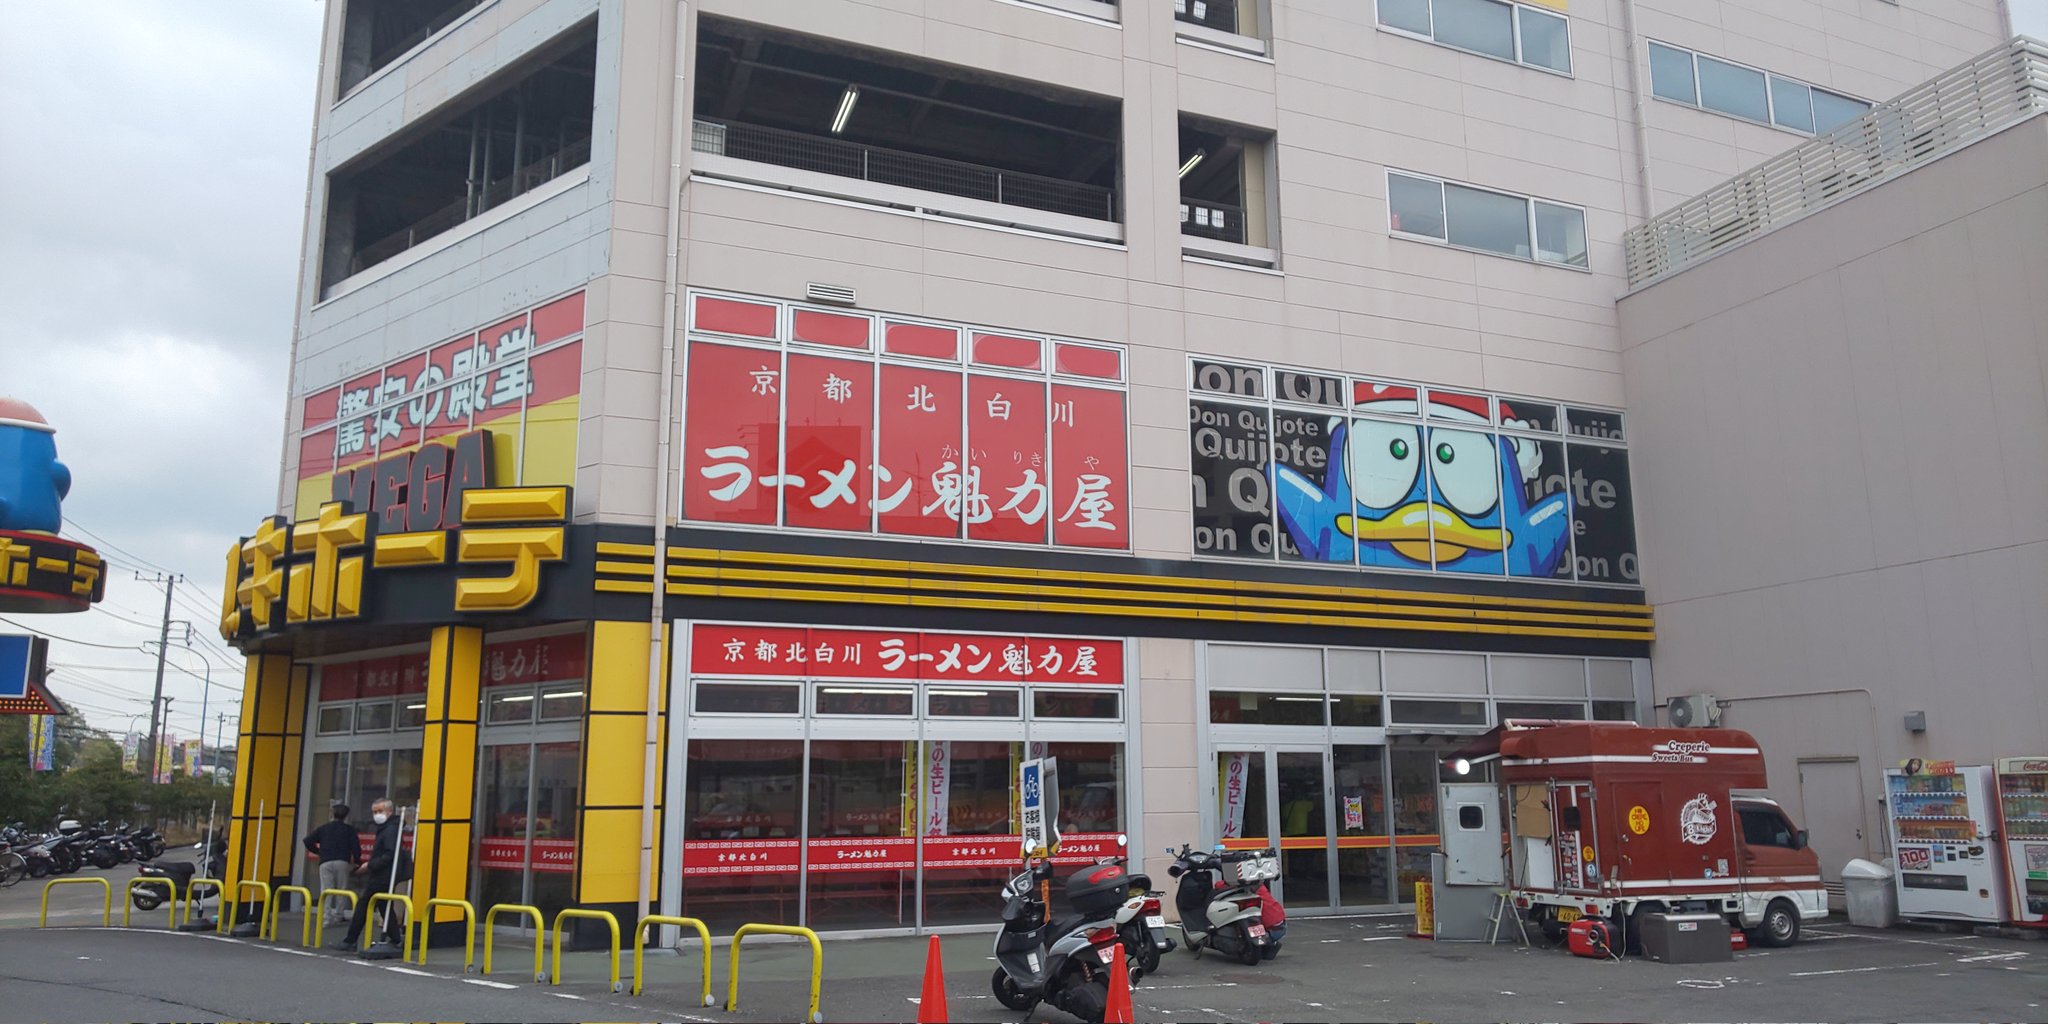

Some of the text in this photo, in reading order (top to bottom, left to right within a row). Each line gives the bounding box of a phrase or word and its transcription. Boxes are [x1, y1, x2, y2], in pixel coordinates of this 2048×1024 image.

[334, 326, 536, 456] 驚安の殿堂
[749, 365, 1075, 427] 京都北白川
[1193, 364, 1264, 398] on
[332, 429, 493, 533] MEGA
[700, 446, 1117, 531] ラーメン魁力屋
[722, 638, 1099, 676] 京都北白川 ラーメン魁力屋
[1652, 752, 1678, 762] Sweets
[1668, 740, 1710, 754] Creperie
